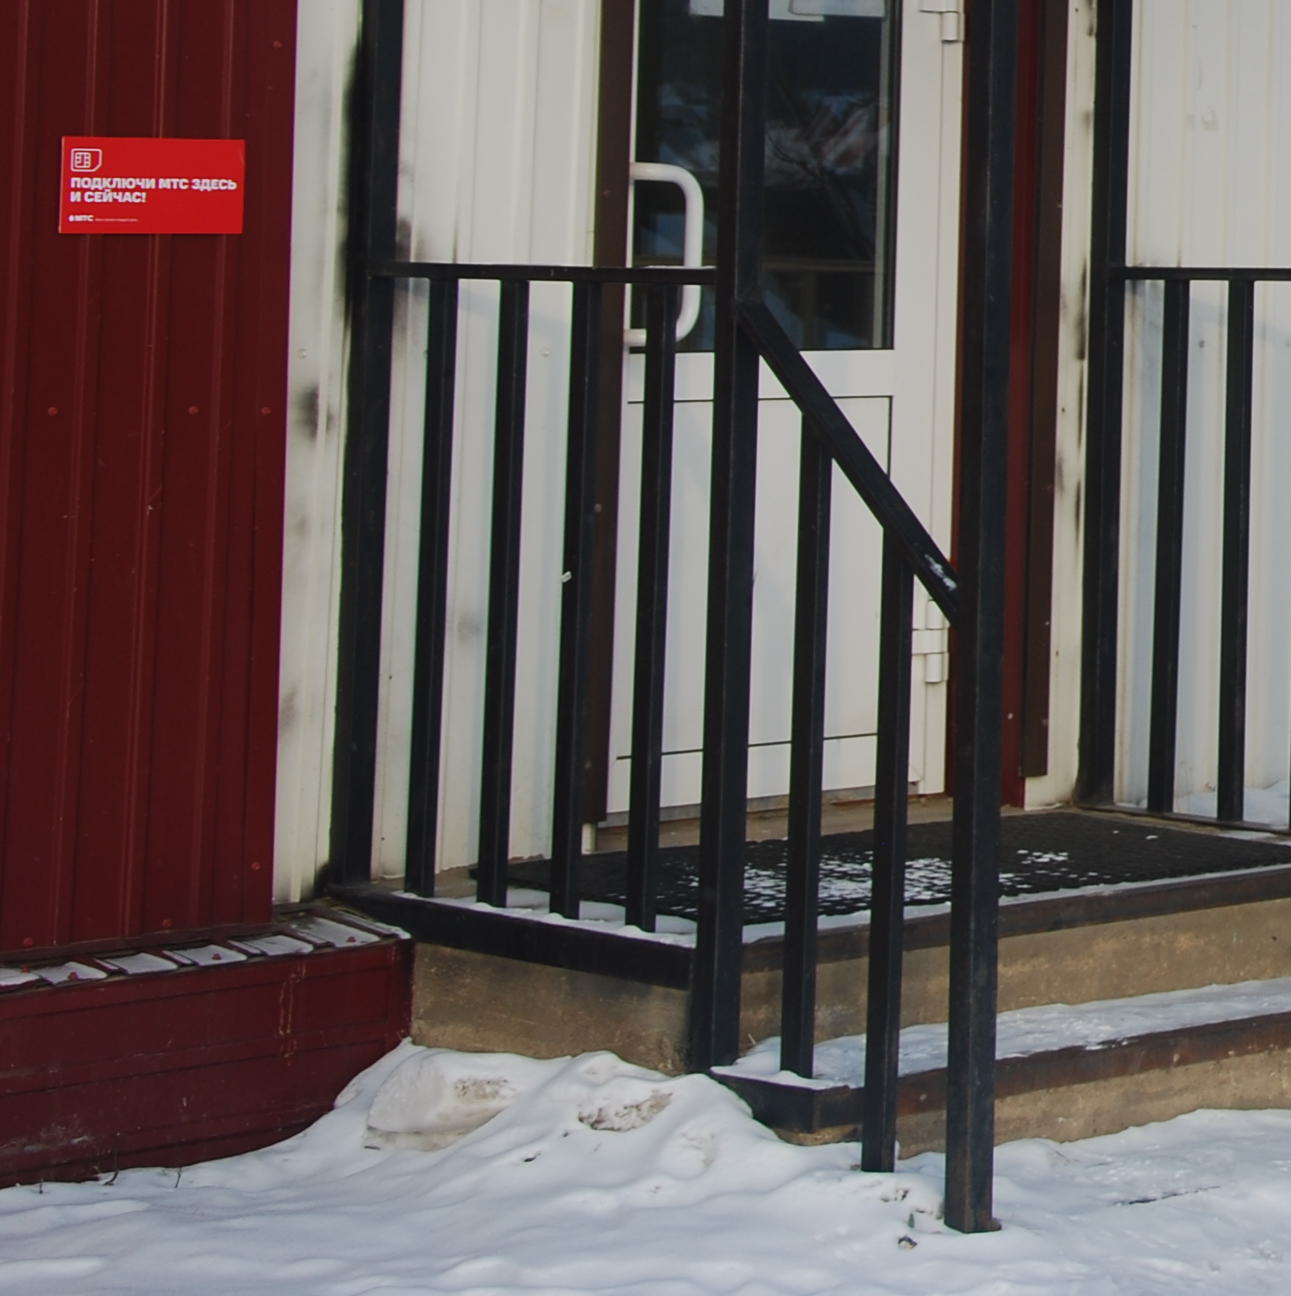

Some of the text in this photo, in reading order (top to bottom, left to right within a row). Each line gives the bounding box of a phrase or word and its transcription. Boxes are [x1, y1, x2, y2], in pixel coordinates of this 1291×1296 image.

[70, 177, 238, 192] ПОДКЛЮЧИ МТС ЗДЕСЬ
[70, 189, 147, 203] И СЕЙЧАС!
